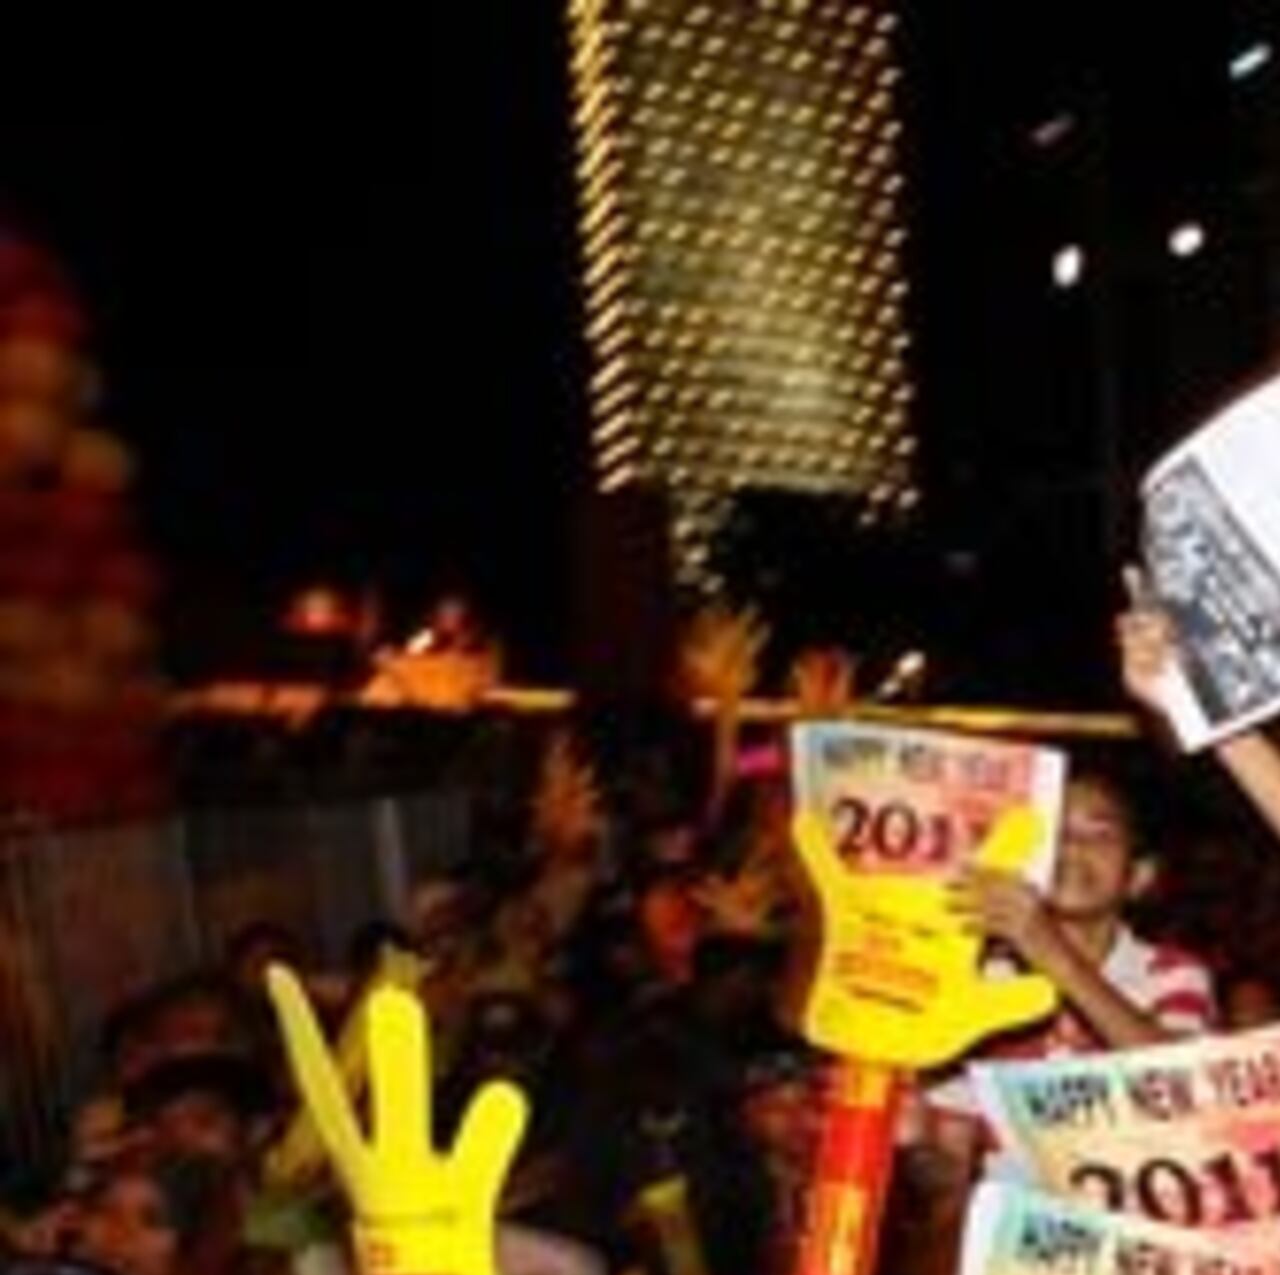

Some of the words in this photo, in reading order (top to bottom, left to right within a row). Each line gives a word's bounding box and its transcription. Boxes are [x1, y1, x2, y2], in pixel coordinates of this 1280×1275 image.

[831, 792, 986, 863] 201
[1028, 1071, 1116, 1129] HAPPY
[1131, 1067, 1199, 1121] NEW
